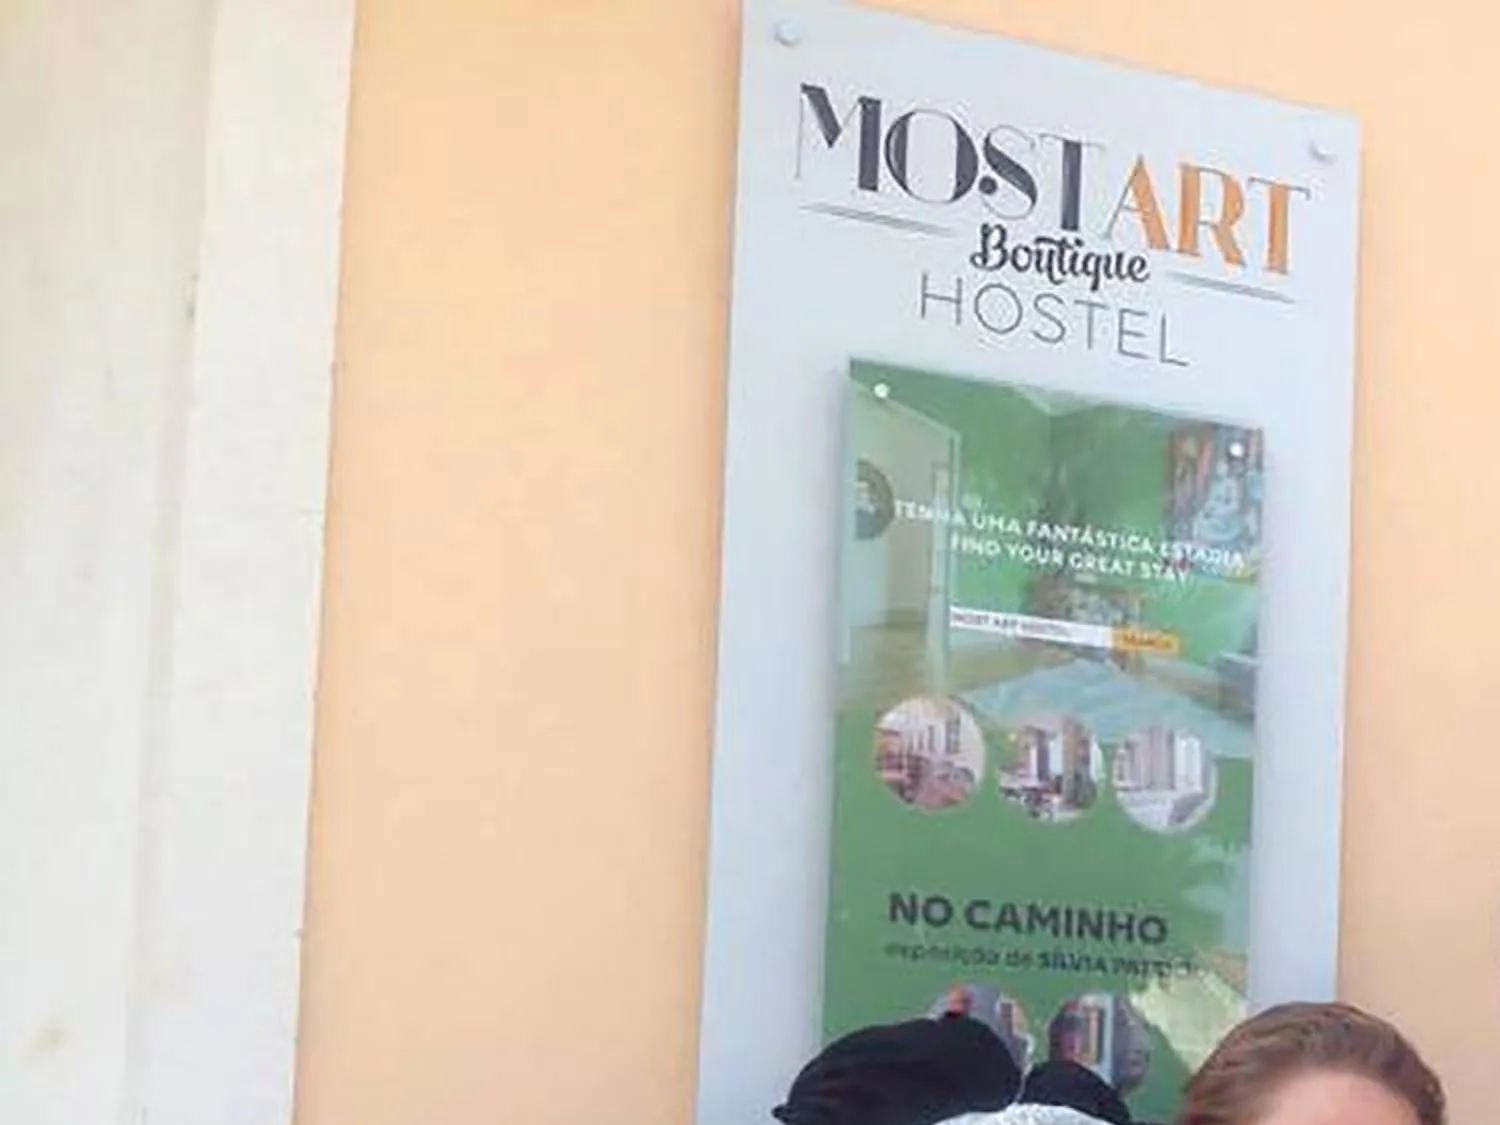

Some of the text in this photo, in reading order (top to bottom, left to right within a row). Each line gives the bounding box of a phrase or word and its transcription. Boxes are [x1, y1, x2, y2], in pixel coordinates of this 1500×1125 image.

[969, 223, 1151, 292] Boutique
[919, 272, 1191, 368] HOSTEL
[973, 511, 1023, 536] UMA
[950, 532, 1001, 557] FIND
[1005, 541, 1064, 568] YOUR
[1068, 549, 1135, 577] GREAT
[888, 891, 1169, 945] NO CAMINHO
